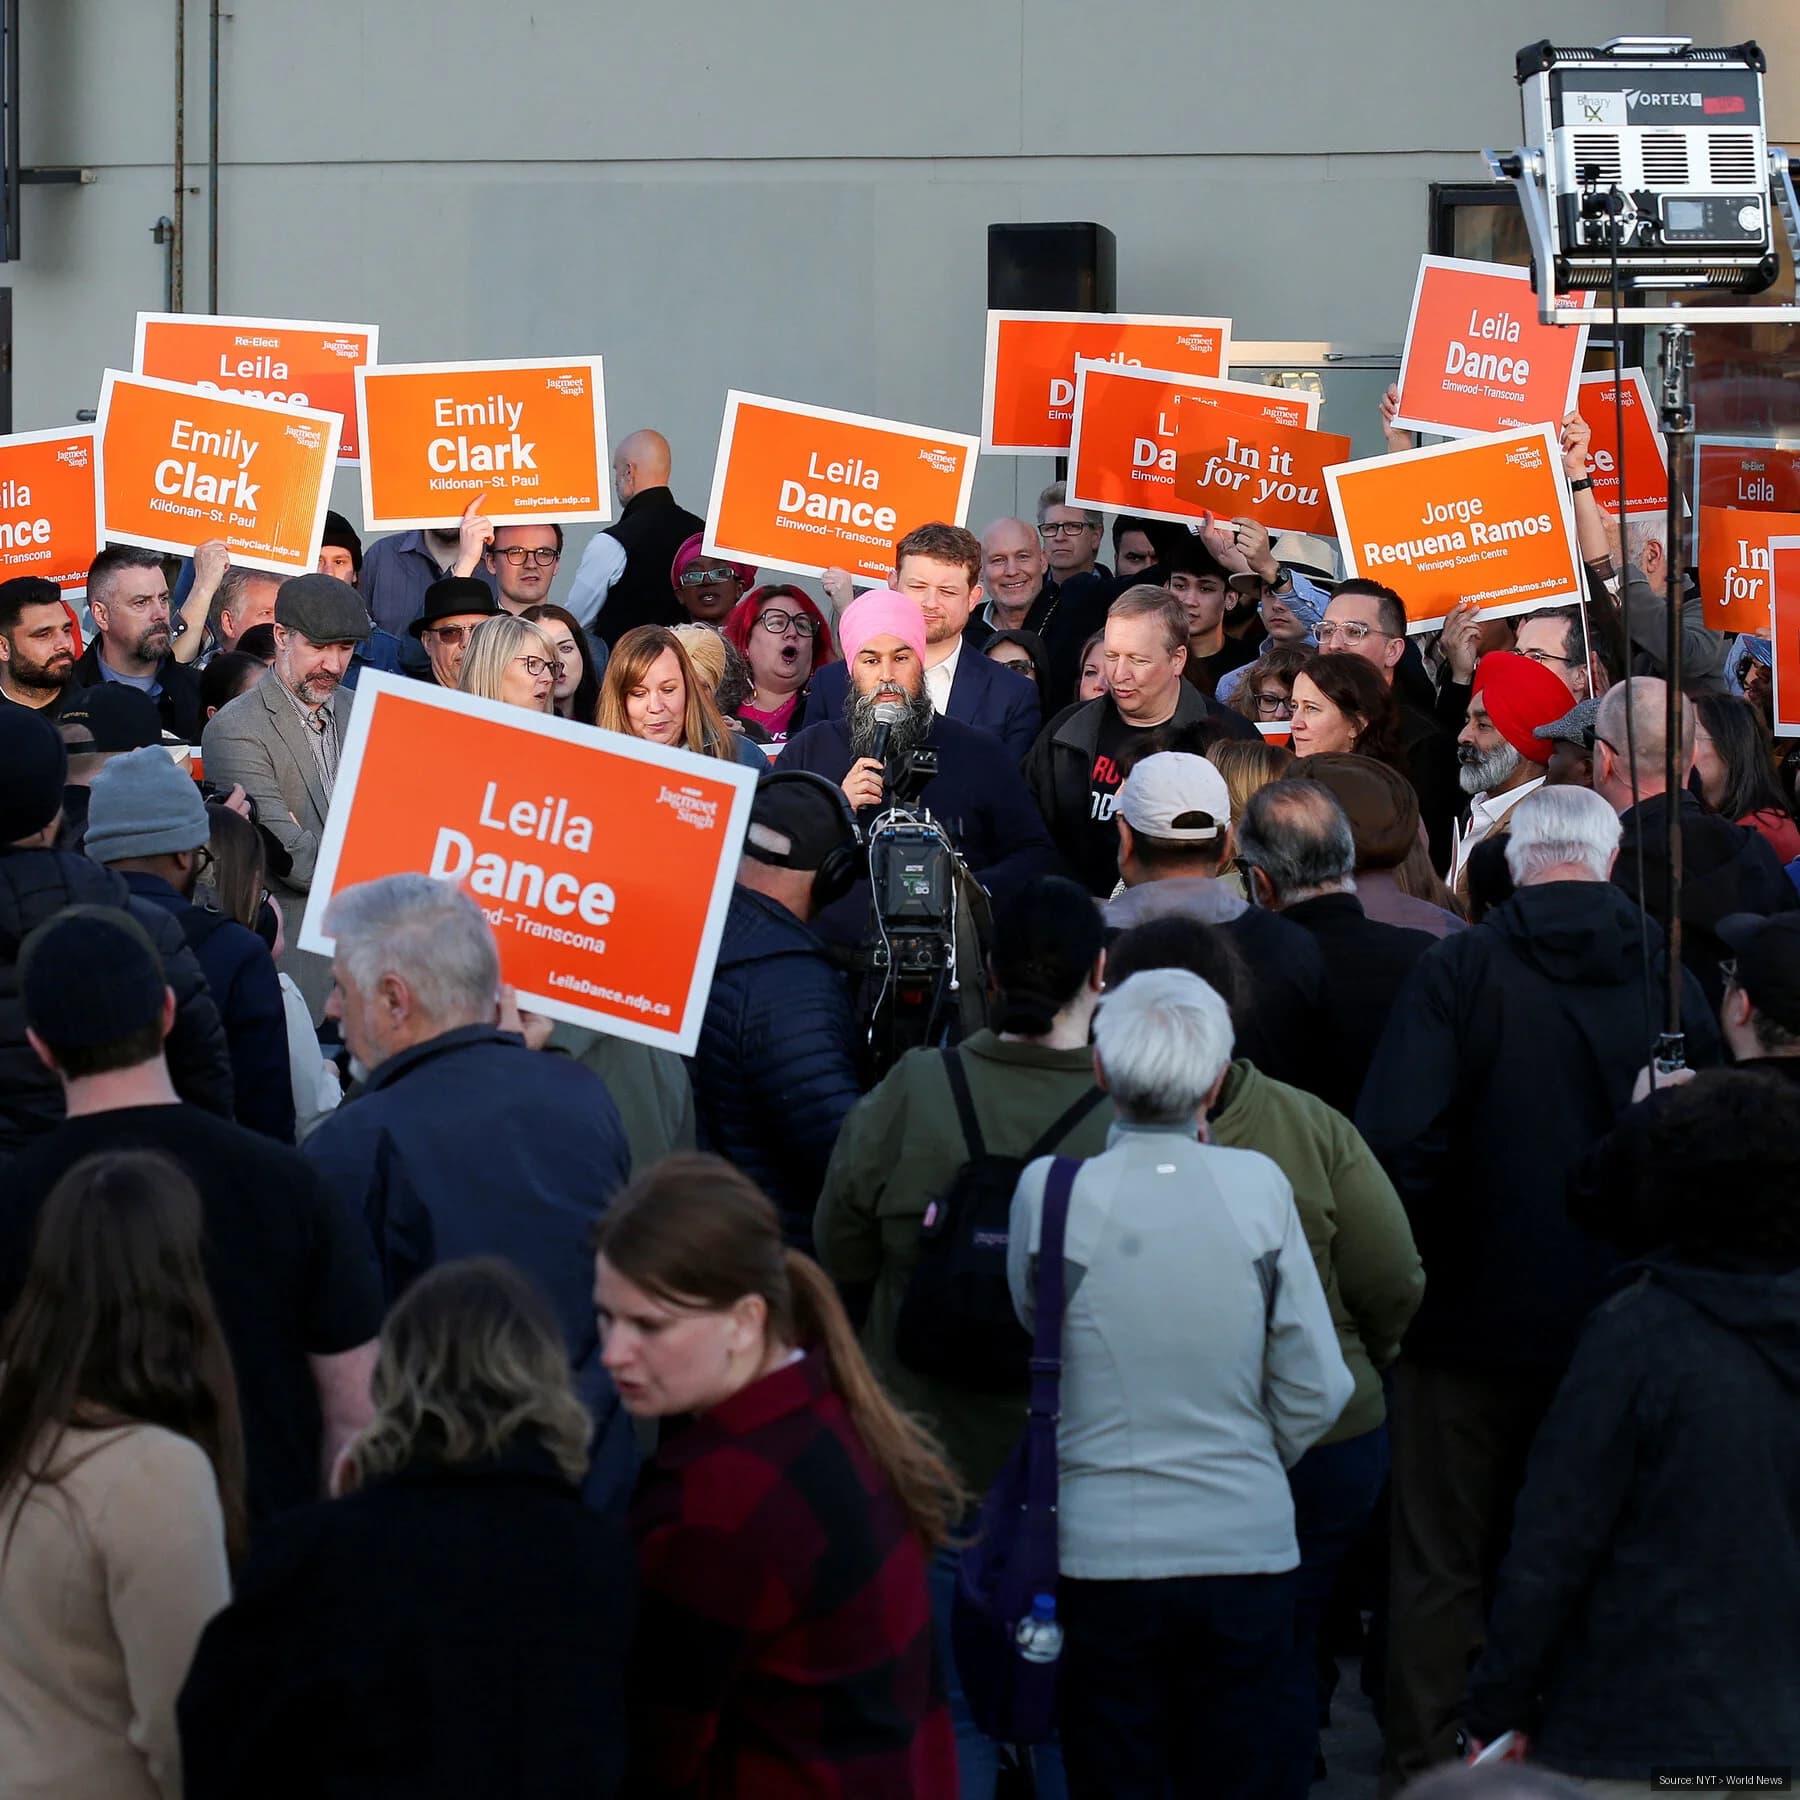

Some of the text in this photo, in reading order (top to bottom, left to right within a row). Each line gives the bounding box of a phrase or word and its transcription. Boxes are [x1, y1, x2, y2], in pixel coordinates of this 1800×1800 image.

[1468, 309, 1521, 343] Leila
[235, 336, 279, 348] Re-Elect
[322, 341, 359, 352] Jagmeet
[1176, 335, 1213, 346] Jagmeet
[1190, 344, 1213, 353] Singh
[336, 350, 359, 358] Singh
[1445, 341, 1530, 385] Dance
[220, 354, 288, 380] Leila
[546, 377, 583, 389] Jagmeet
[560, 385, 584, 396] Singh
[434, 394, 523, 431] Emily
[1261, 406, 1298, 419] Jagmeet
[1275, 417, 1298, 426] Singh
[170, 420, 259, 468] Emily
[284, 425, 320, 439] Jagmeet
[297, 437, 320, 449] Singh
[57, 448, 87, 461] Jagmeet
[68, 457, 88, 467] Singh
[427, 433, 537, 473] Clark
[918, 449, 957, 465] Jagmeet
[1225, 436, 1294, 476] In it
[1505, 449, 1541, 465] Jagmeet
[1520, 457, 1542, 469] Singh
[807, 452, 880, 490] Leila
[931, 460, 955, 473] Singh
[154, 459, 260, 511] Clark
[512, 474, 539, 487] Paul
[1197, 456, 1249, 491] for
[1252, 476, 1319, 506] you
[1738, 477, 1774, 502] Leila
[0, 480, 31, 508] ila
[514, 495, 591, 507] EmilyClark.ndp.ca
[778, 479, 897, 532] Dance
[229, 512, 256, 528] Paul
[1421, 497, 1483, 526] Jorge
[0, 518, 51, 549] nce
[226, 535, 300, 557] EmilyClark.ndp.ca
[1363, 514, 1552, 567] Requena Ramos
[0, 550, 51, 565] –Transcona
[1416, 546, 1509, 573] Winnipeg South Centre
[1737, 539, 1770, 571] In
[1458, 577, 1568, 604] JorgeRequenaRamos.ndp.ca
[1719, 567, 1763, 606] for
[655, 785, 717, 816] Jagmeet
[478, 781, 594, 854] Leila
[676, 808, 714, 830] Singh
[429, 826, 616, 926] Dance
[548, 970, 671, 1016] LeilaDance.ndp.ca
